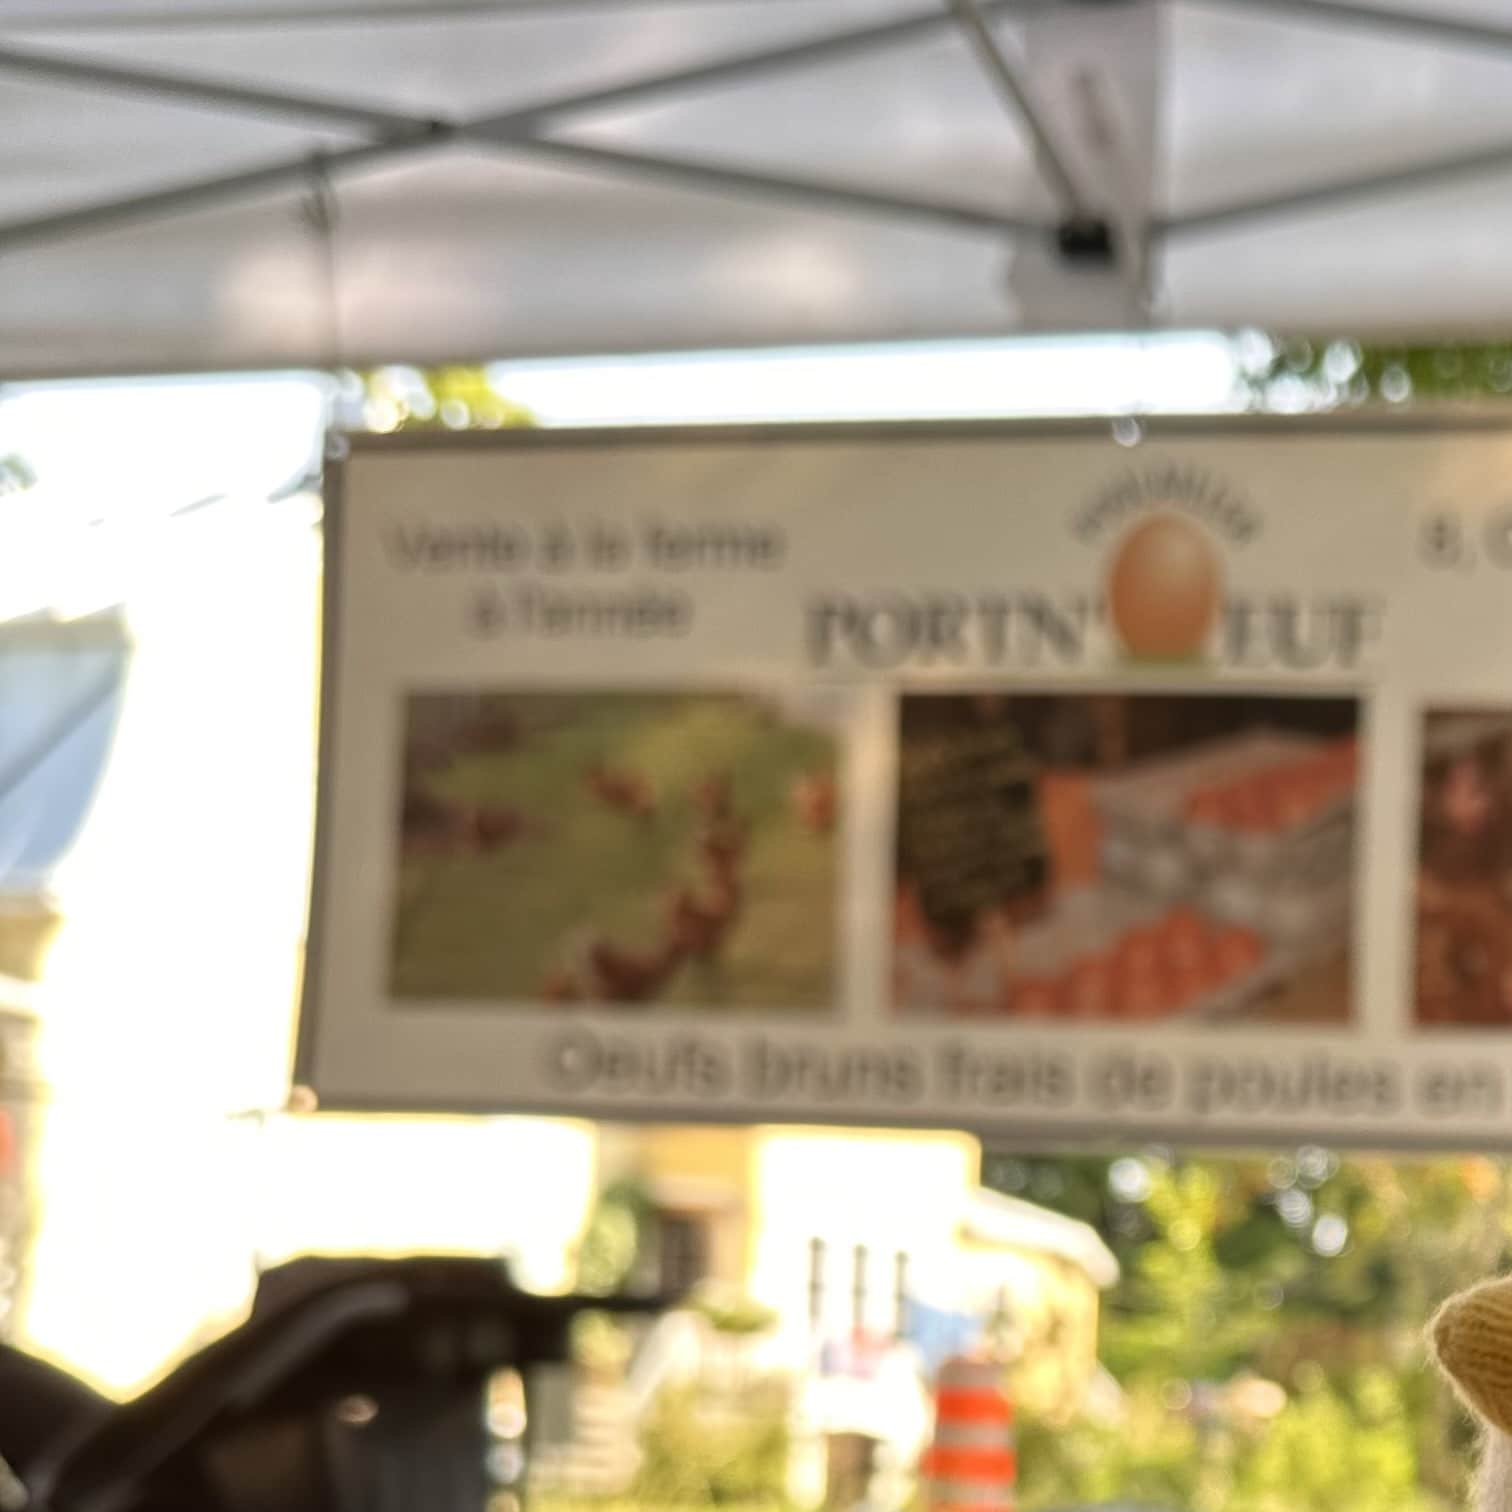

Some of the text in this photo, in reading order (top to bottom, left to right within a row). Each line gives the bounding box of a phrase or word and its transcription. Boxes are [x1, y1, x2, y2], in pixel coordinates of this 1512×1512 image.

[742, 1033, 925, 1105] bruns
[935, 1030, 1076, 1107] frais
[1096, 1043, 1176, 1112] de
[1189, 1044, 1404, 1122] poules
[1412, 1053, 1505, 1119] en
